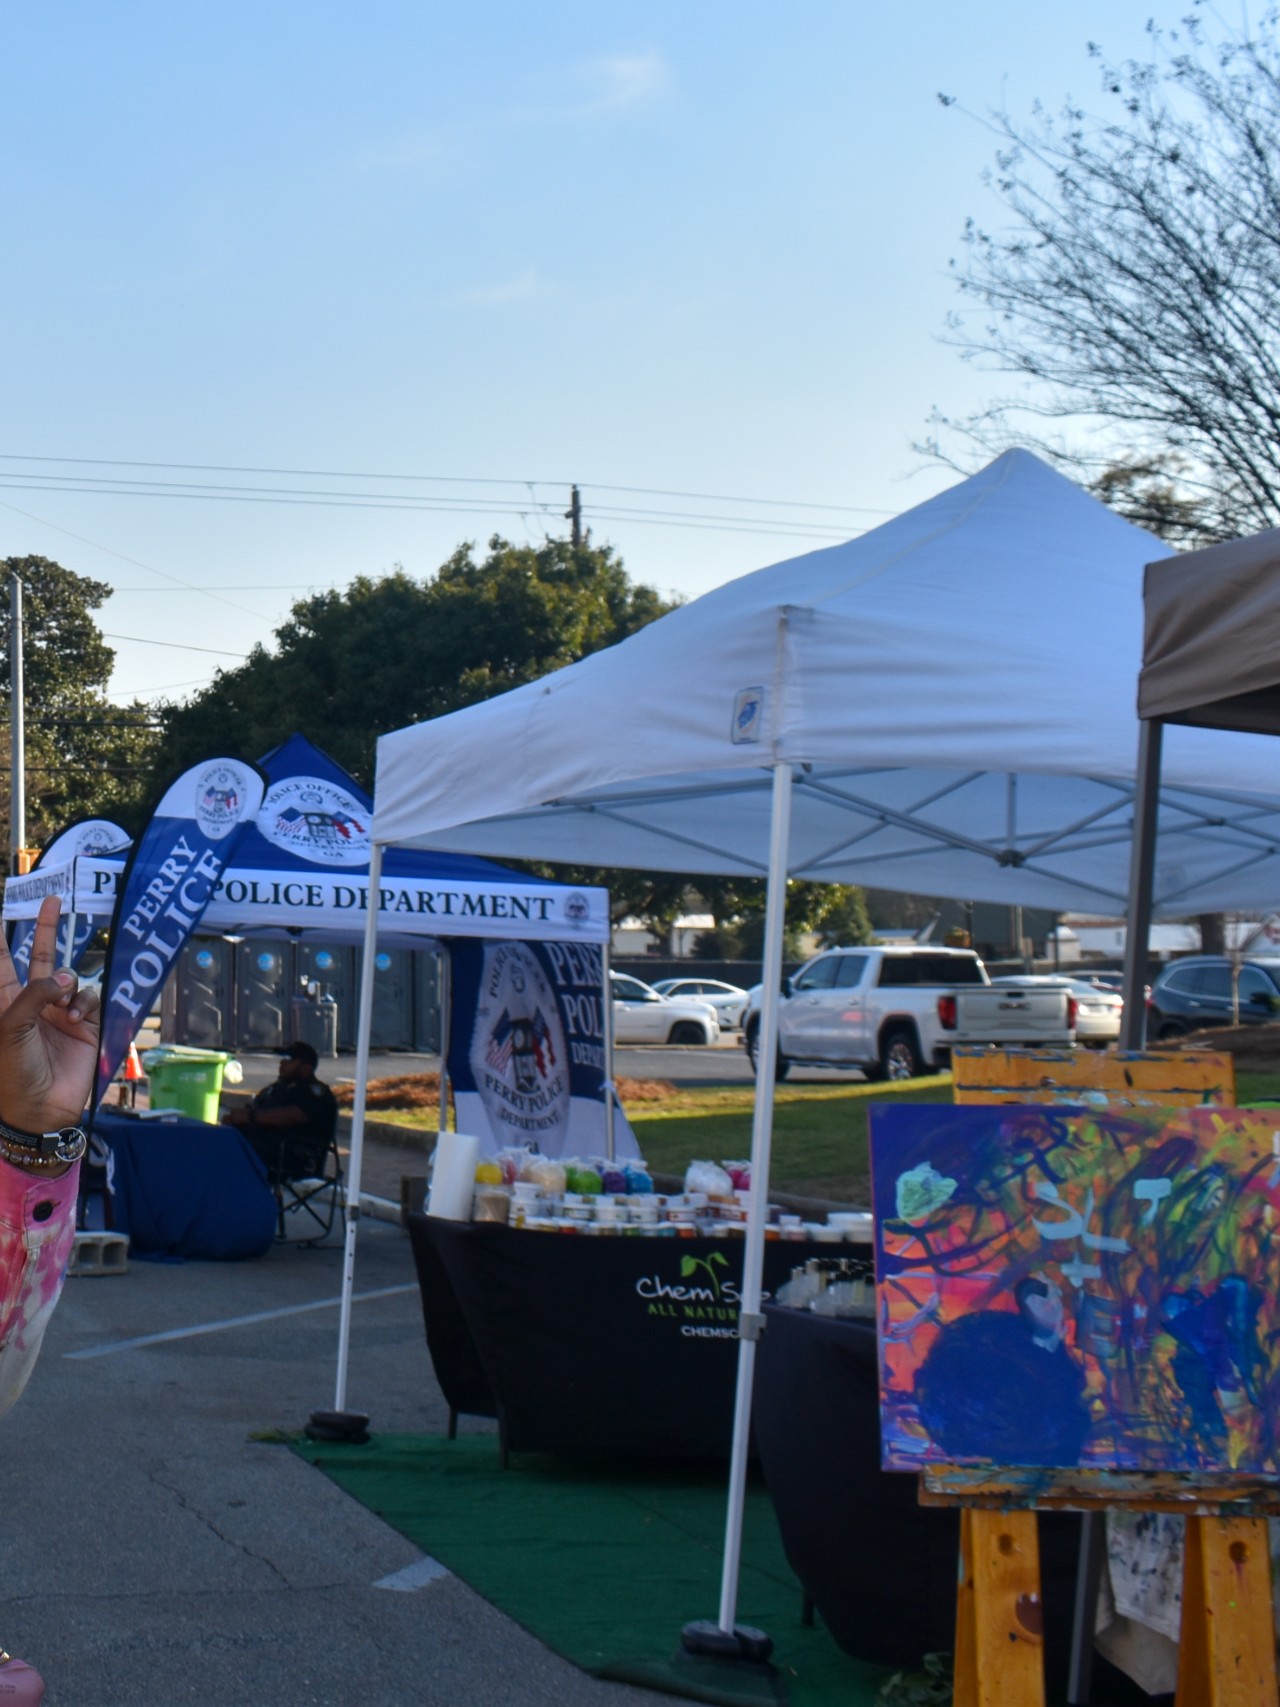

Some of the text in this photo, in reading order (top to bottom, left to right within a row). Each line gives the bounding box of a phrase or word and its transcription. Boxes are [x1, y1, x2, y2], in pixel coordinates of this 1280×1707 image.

[122, 835, 198, 940] PERRY
[110, 849, 222, 1018] POLICE
[542, 942, 603, 987] PERR
[561, 993, 603, 1038] POL
[484, 1074, 564, 1113] PERRY POLICE
[500, 1107, 560, 1131] DEPARTMENT
[648, 1303, 738, 1321] ALL NATUR
